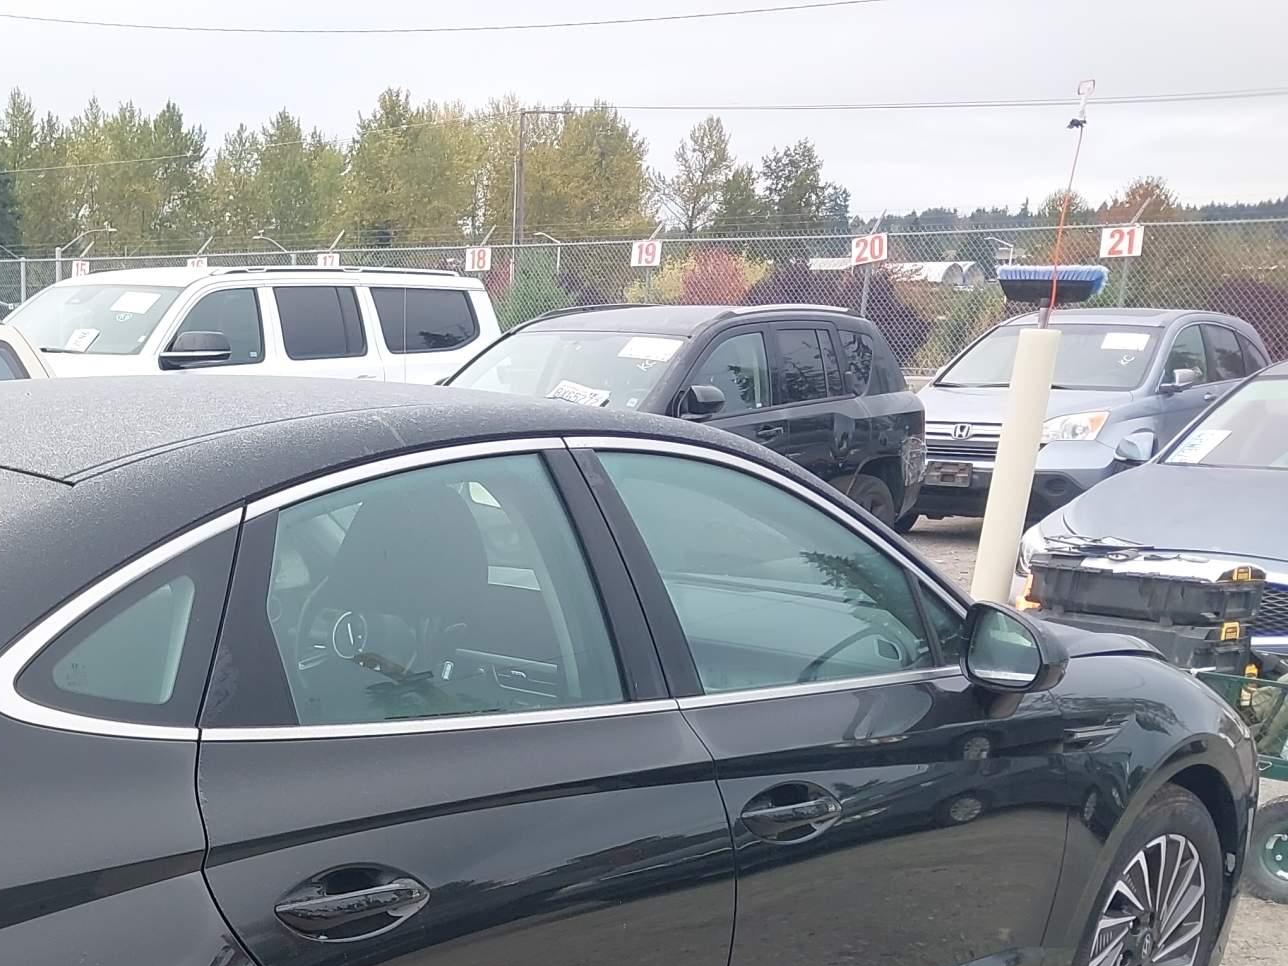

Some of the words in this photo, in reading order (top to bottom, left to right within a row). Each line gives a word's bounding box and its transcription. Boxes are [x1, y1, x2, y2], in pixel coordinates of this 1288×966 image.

[637, 242, 656, 265] 19
[855, 235, 884, 263] 20
[1108, 228, 1136, 256] 21
[322, 254, 335, 267] 17
[471, 249, 486, 269] 18
